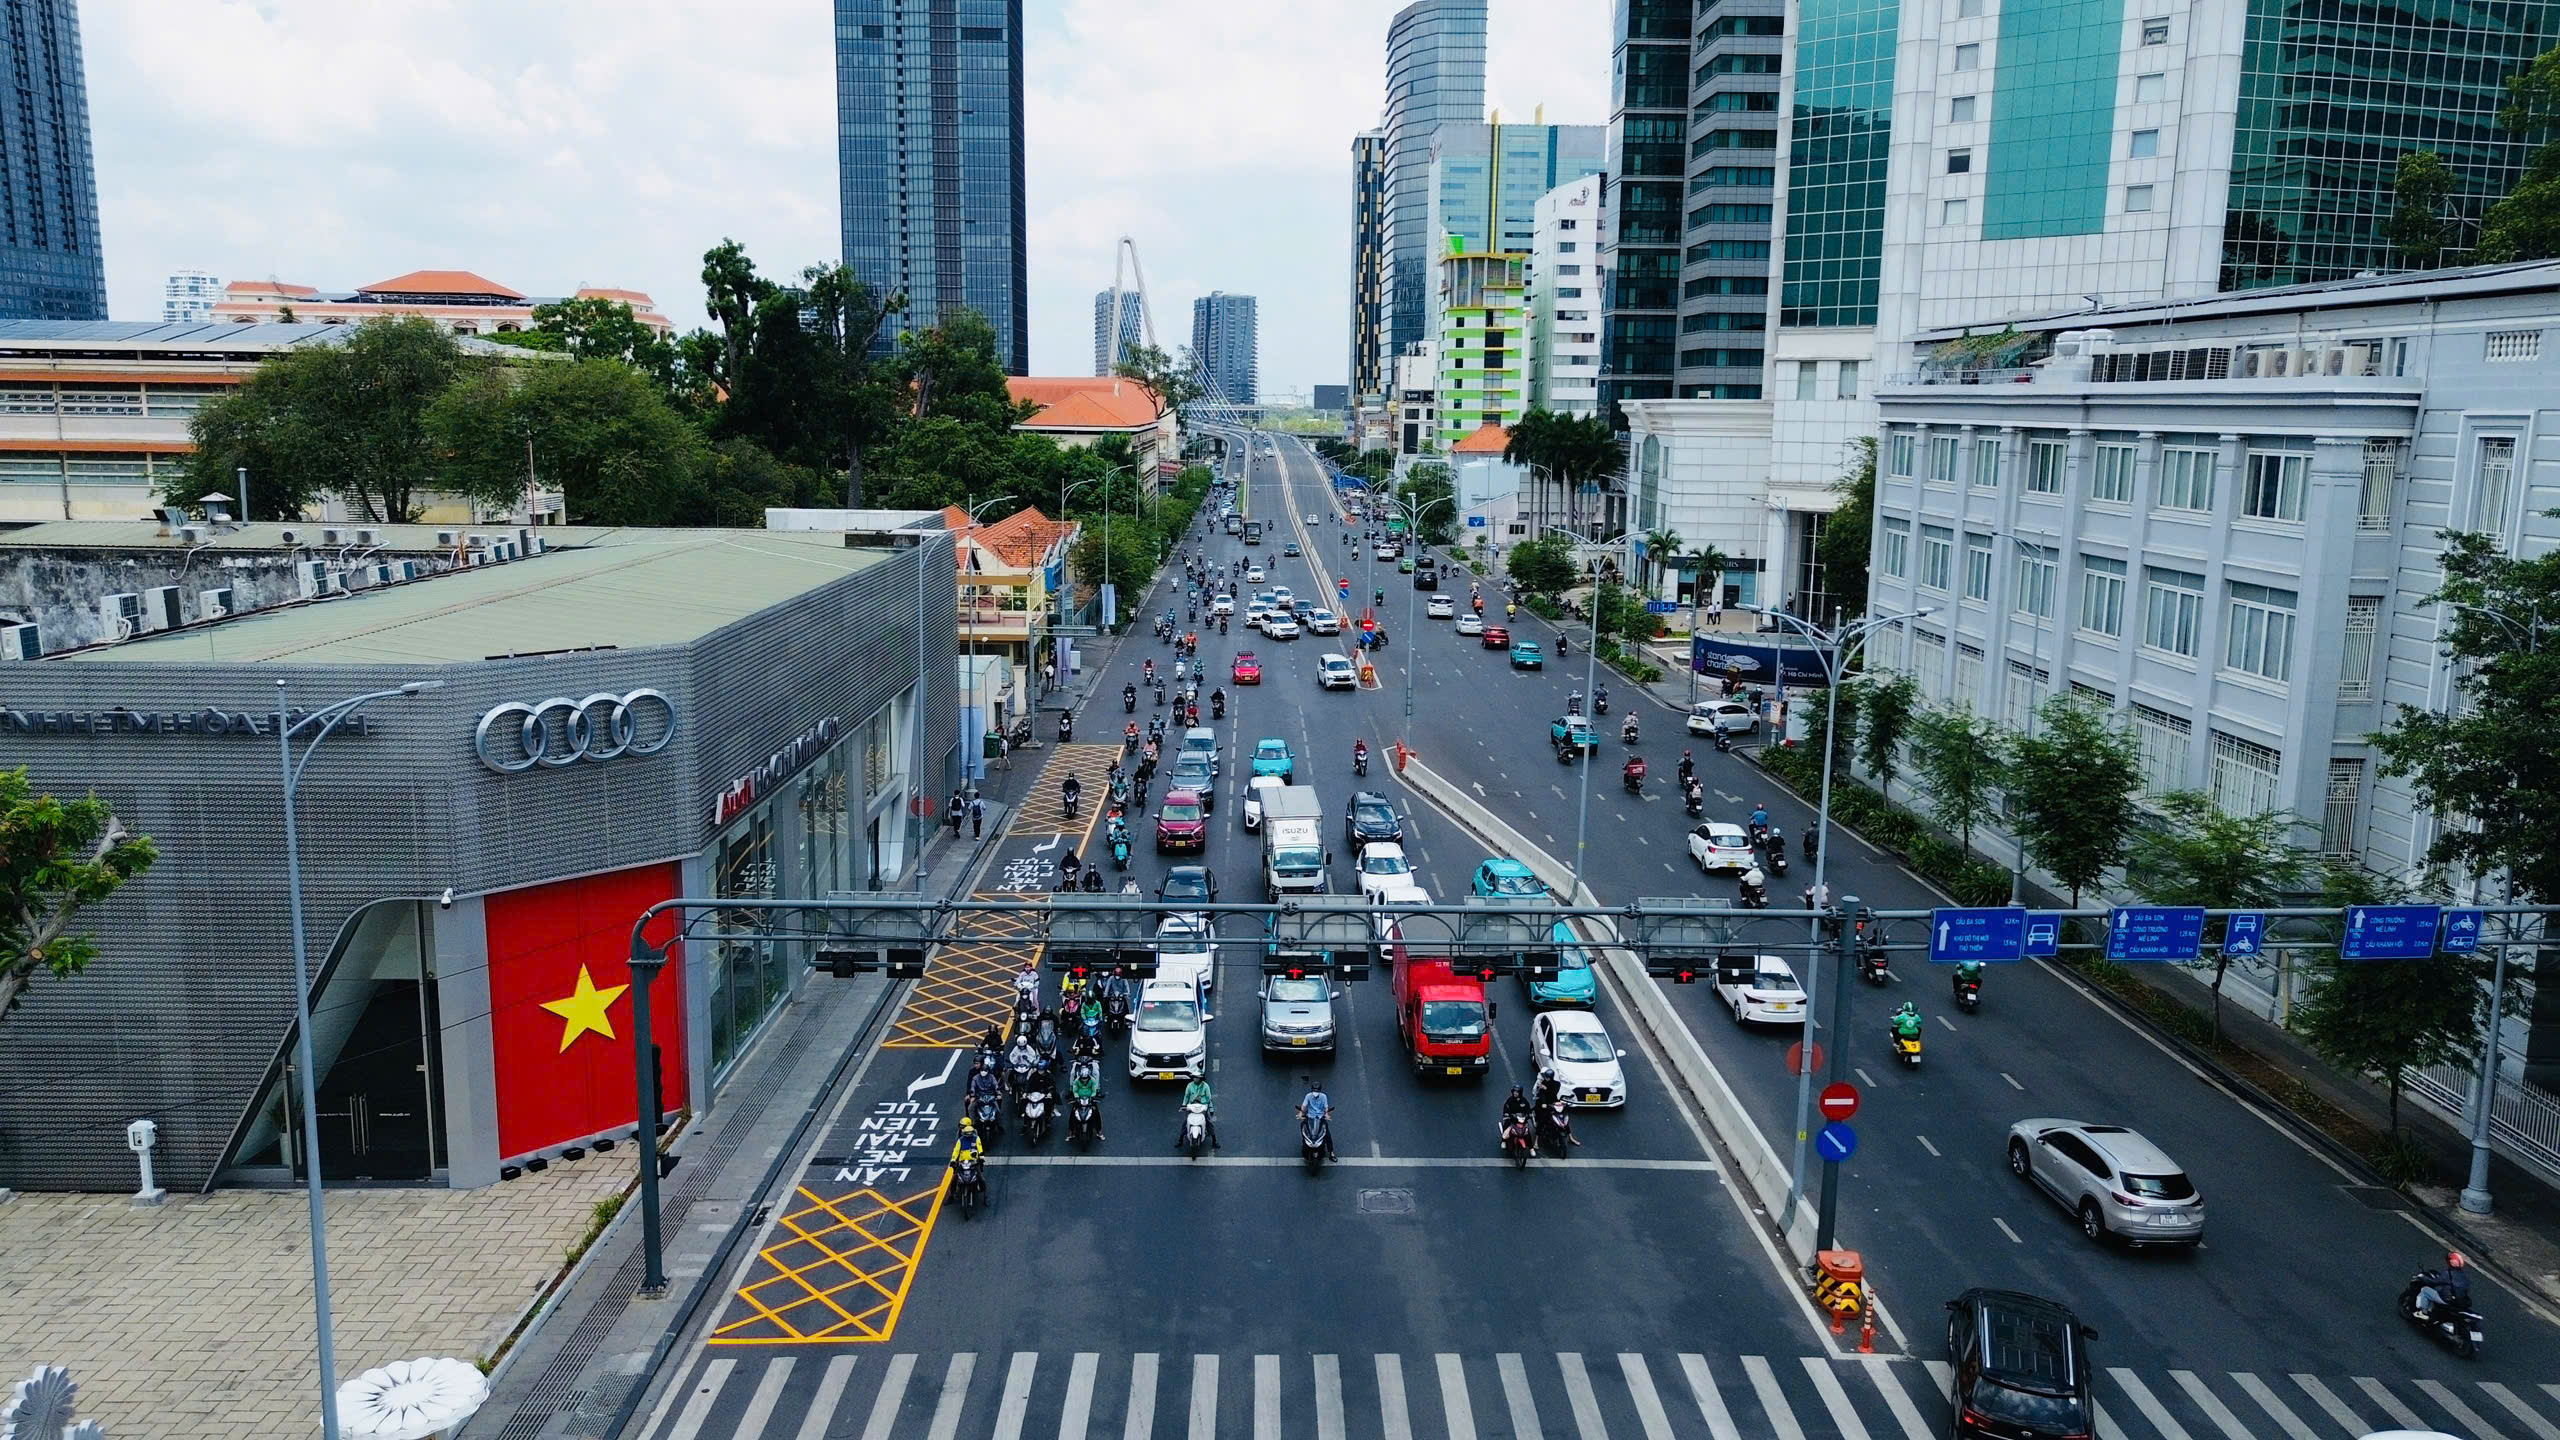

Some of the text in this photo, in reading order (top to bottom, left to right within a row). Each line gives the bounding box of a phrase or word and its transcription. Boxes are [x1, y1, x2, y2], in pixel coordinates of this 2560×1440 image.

[103, 710, 164, 735] TM
[173, 706, 261, 735] HÒA
[715, 776, 750, 824] Audi
[1282, 827, 1309, 835] ISUZU
[874, 1100, 938, 1115] TỤC
[834, 1167, 912, 1186] LÀN
